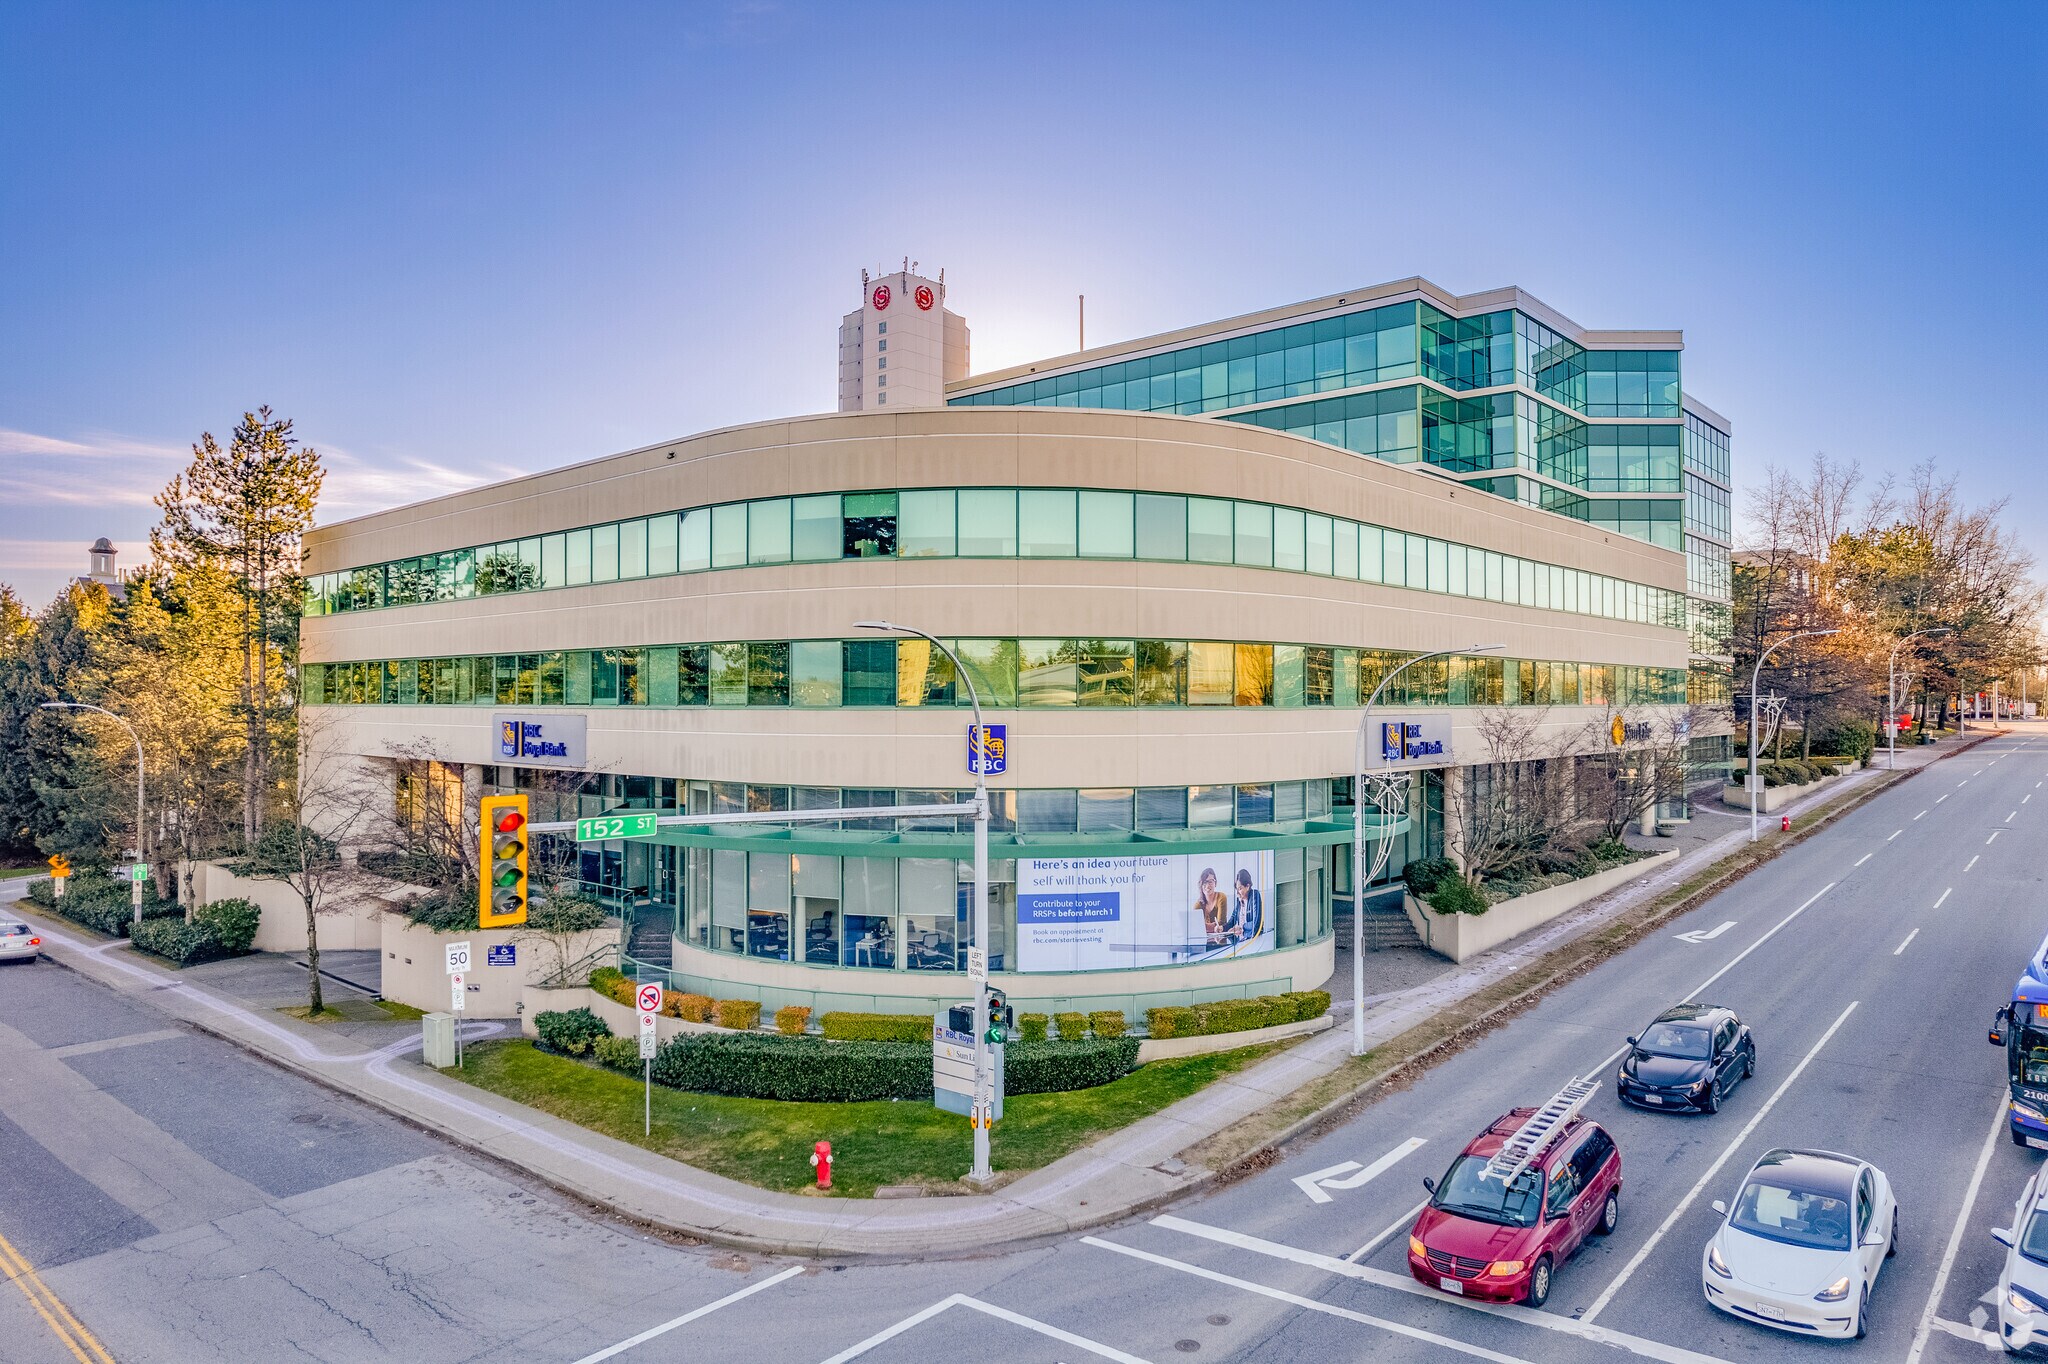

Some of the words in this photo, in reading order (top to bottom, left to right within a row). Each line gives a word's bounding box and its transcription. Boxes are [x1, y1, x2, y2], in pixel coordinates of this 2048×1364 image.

[524, 724, 542, 738] RBC
[1406, 724, 1422, 739] RBC
[503, 745, 515, 753] RBC
[524, 741, 544, 758] Royal
[544, 742, 567, 757] Bank
[1387, 749, 1399, 758] RBC
[1406, 741, 1427, 759] Royal
[1427, 740, 1444, 755] Bank
[972, 759, 1003, 771] RBC
[582, 819, 624, 839] 152
[637, 817, 652, 829] ST
[1033, 859, 1069, 870] Here's
[1071, 861, 1085, 869] an
[1087, 858, 1111, 869] idea
[1113, 859, 1137, 871] your
[1139, 856, 1169, 867] future
[1033, 875, 1054, 887] self
[1055, 875, 1074, 886] will
[1077, 874, 1107, 886] thank
[1109, 876, 1129, 887] you
[1131, 872, 1146, 884] for
[1032, 900, 1074, 908] Contribute
[1083, 900, 1101, 909] your
[1033, 910, 1056, 918] RRSPs
[1058, 908, 1083, 917] before
[1084, 907, 1109, 917] March
[1058, 928, 1097, 936] appointment
[450, 951, 468, 966] 50
[971, 951, 982, 960] LEFT
[971, 959, 983, 968] TURN
[969, 967, 984, 978] SIGNAL
[945, 1029, 957, 1040] RBC
[959, 1033, 975, 1044] Royal
[956, 1050, 968, 1060] Sun
